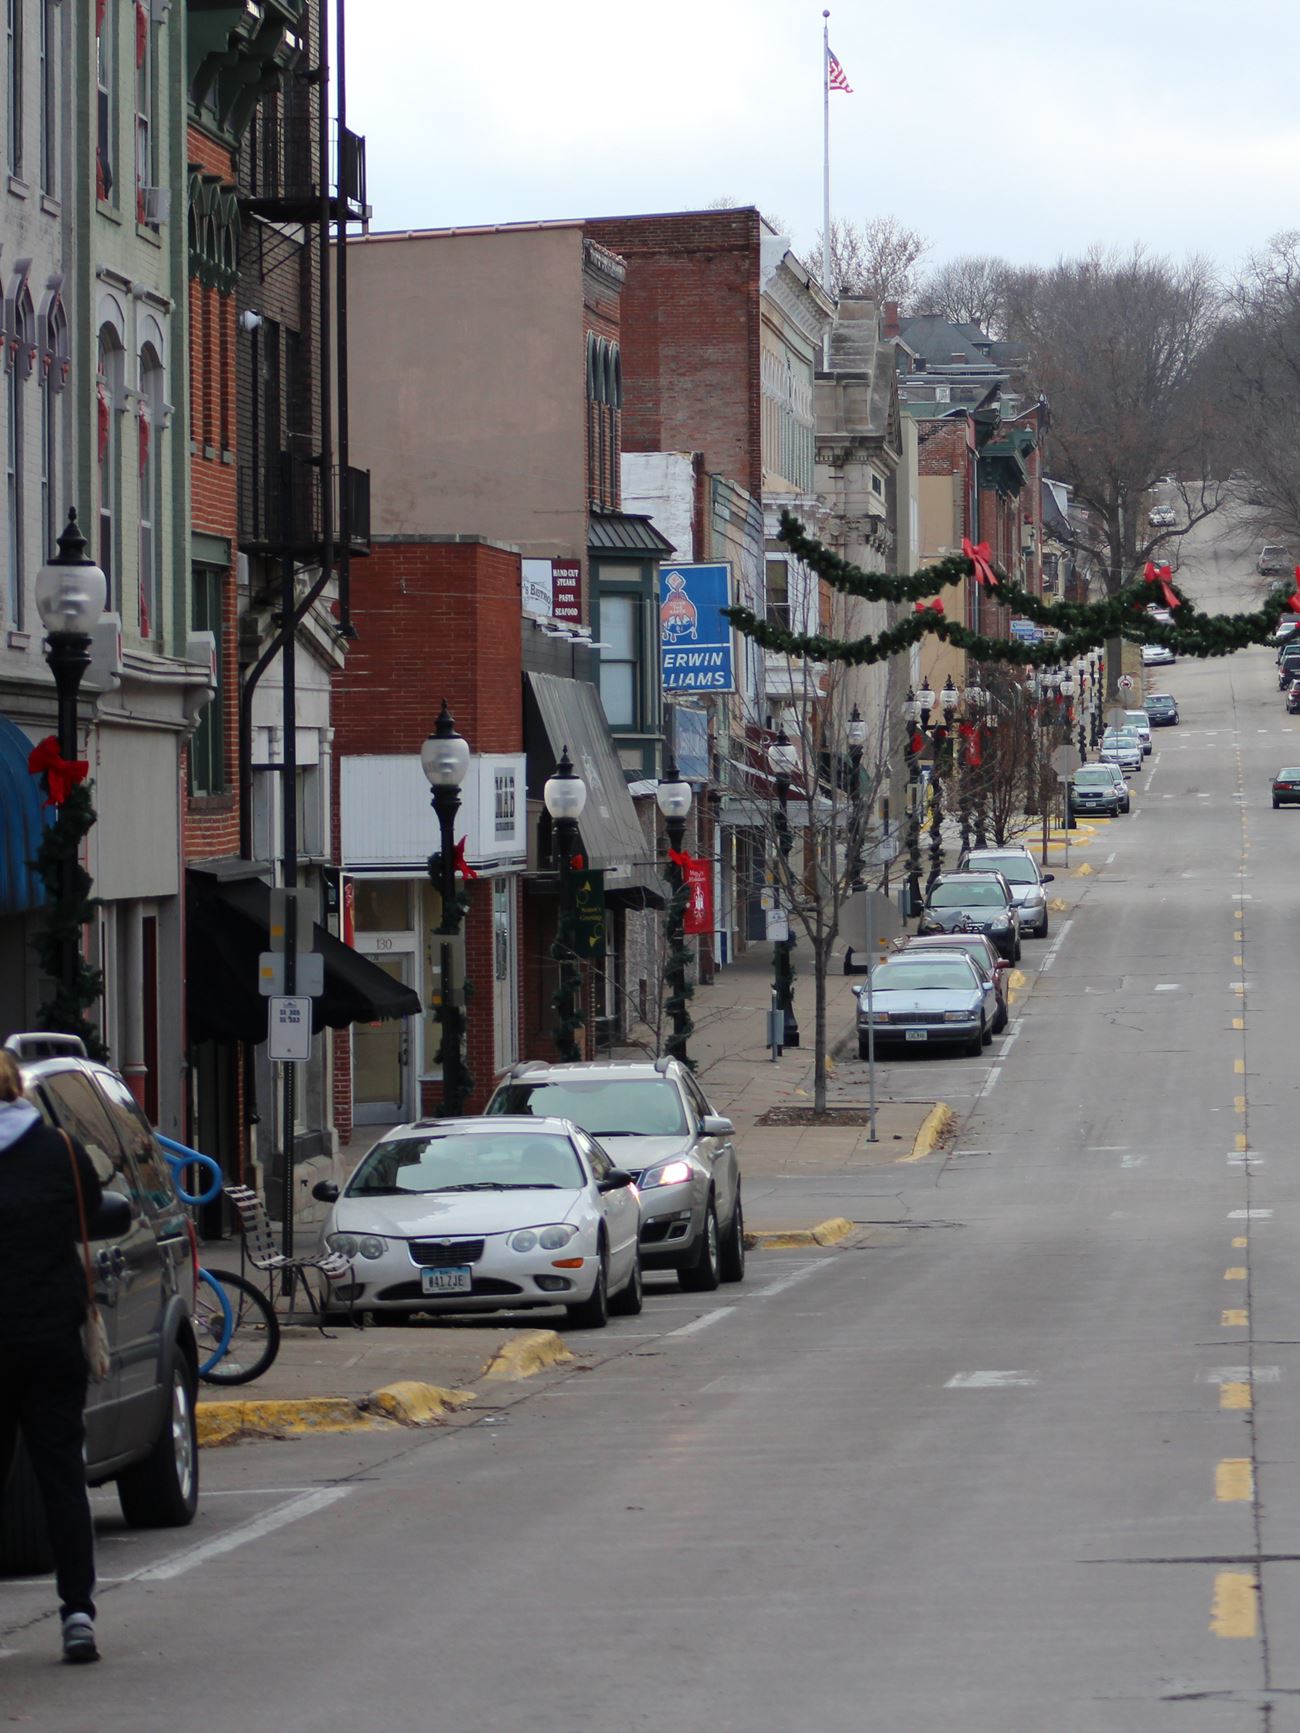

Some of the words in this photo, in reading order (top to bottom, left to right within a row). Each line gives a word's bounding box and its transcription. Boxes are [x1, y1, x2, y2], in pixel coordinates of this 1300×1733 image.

[557, 579, 576, 587] STEAKS
[558, 594, 575, 602] PASTA
[555, 607, 578, 616] SEAFOOD
[663, 652, 723, 667] ERWIN
[376, 938, 392, 950] 130
